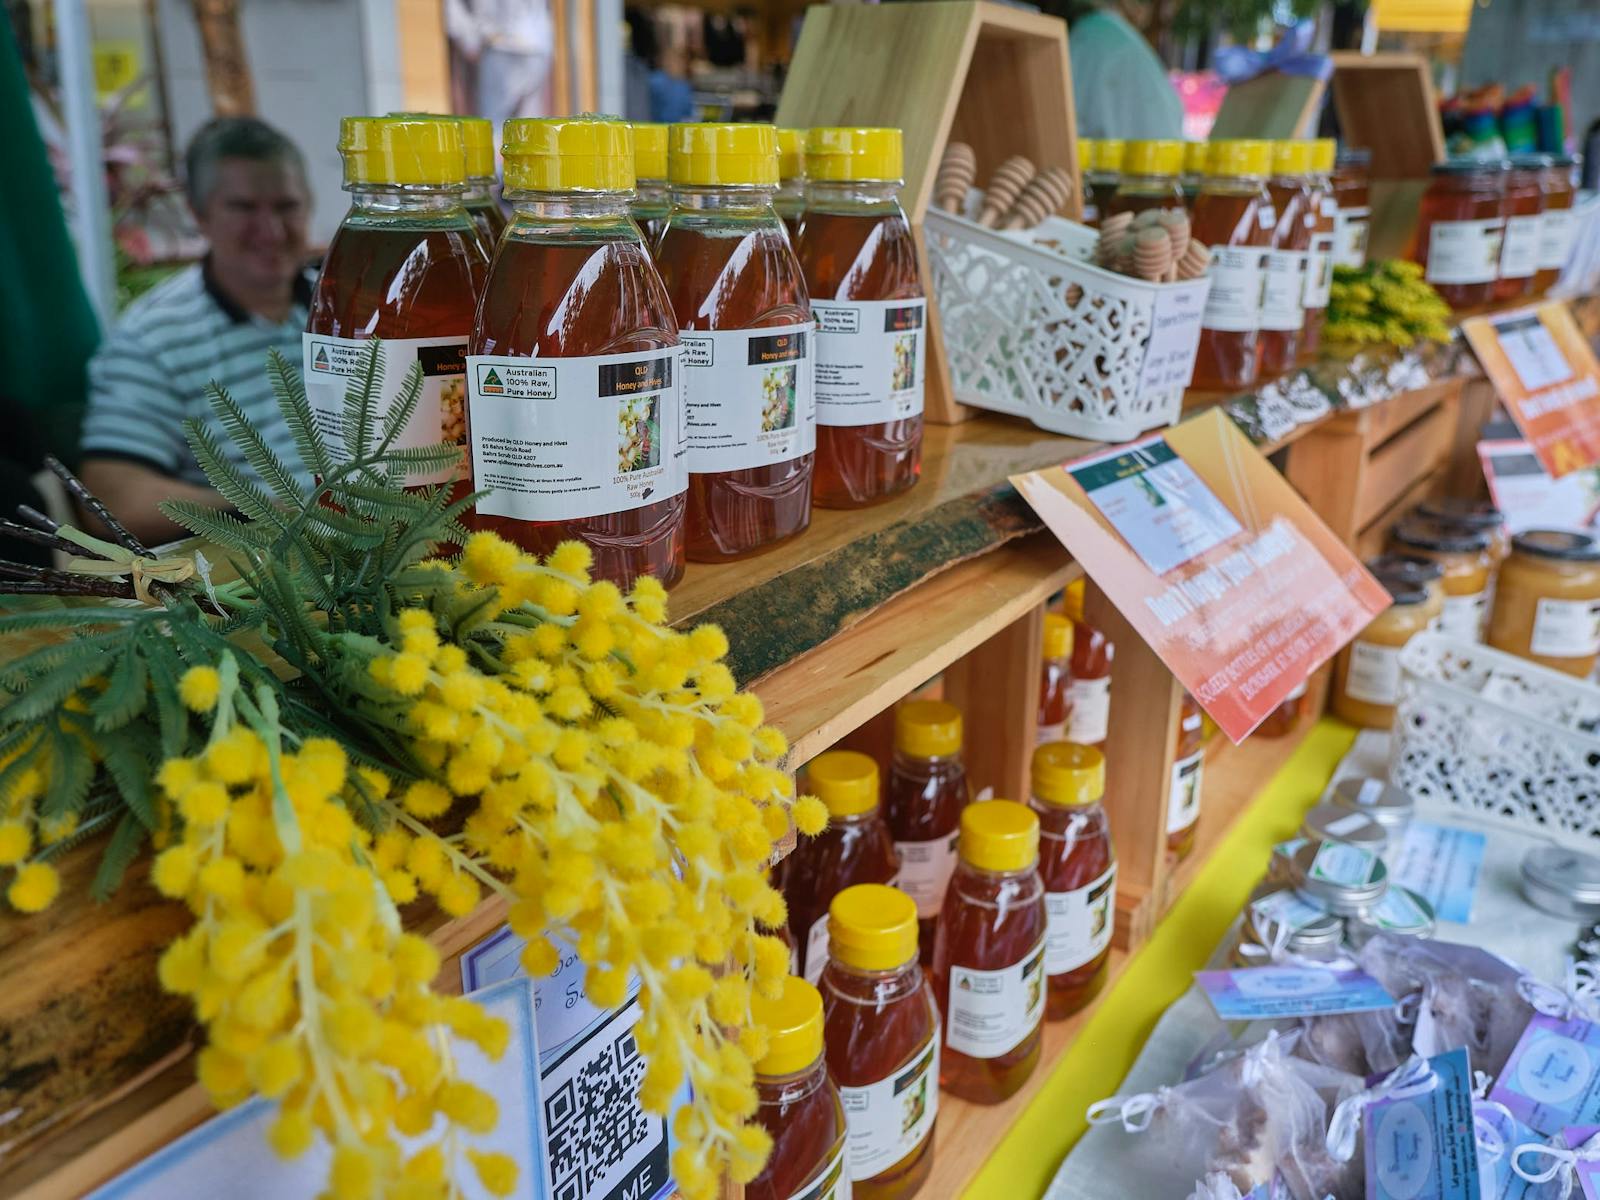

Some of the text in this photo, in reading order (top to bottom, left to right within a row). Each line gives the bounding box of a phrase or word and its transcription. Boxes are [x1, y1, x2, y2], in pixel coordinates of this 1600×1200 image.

[776, 338, 788, 347] QLD
[506, 368, 547, 377] Australian
[634, 365, 648, 376] QLD
[506, 378, 550, 388] 100% Raw,
[615, 382, 636, 391] Honey
[637, 380, 649, 388] and
[507, 388, 552, 398] Pure Honey
[498, 451, 511, 459] Scrub
[483, 459, 563, 468] www.qldhoneyandhives.com.au
[612, 467, 664, 485] 100% Pure Australian
[627, 480, 654, 491] Raw Honey
[622, 1164, 653, 1200] ME
